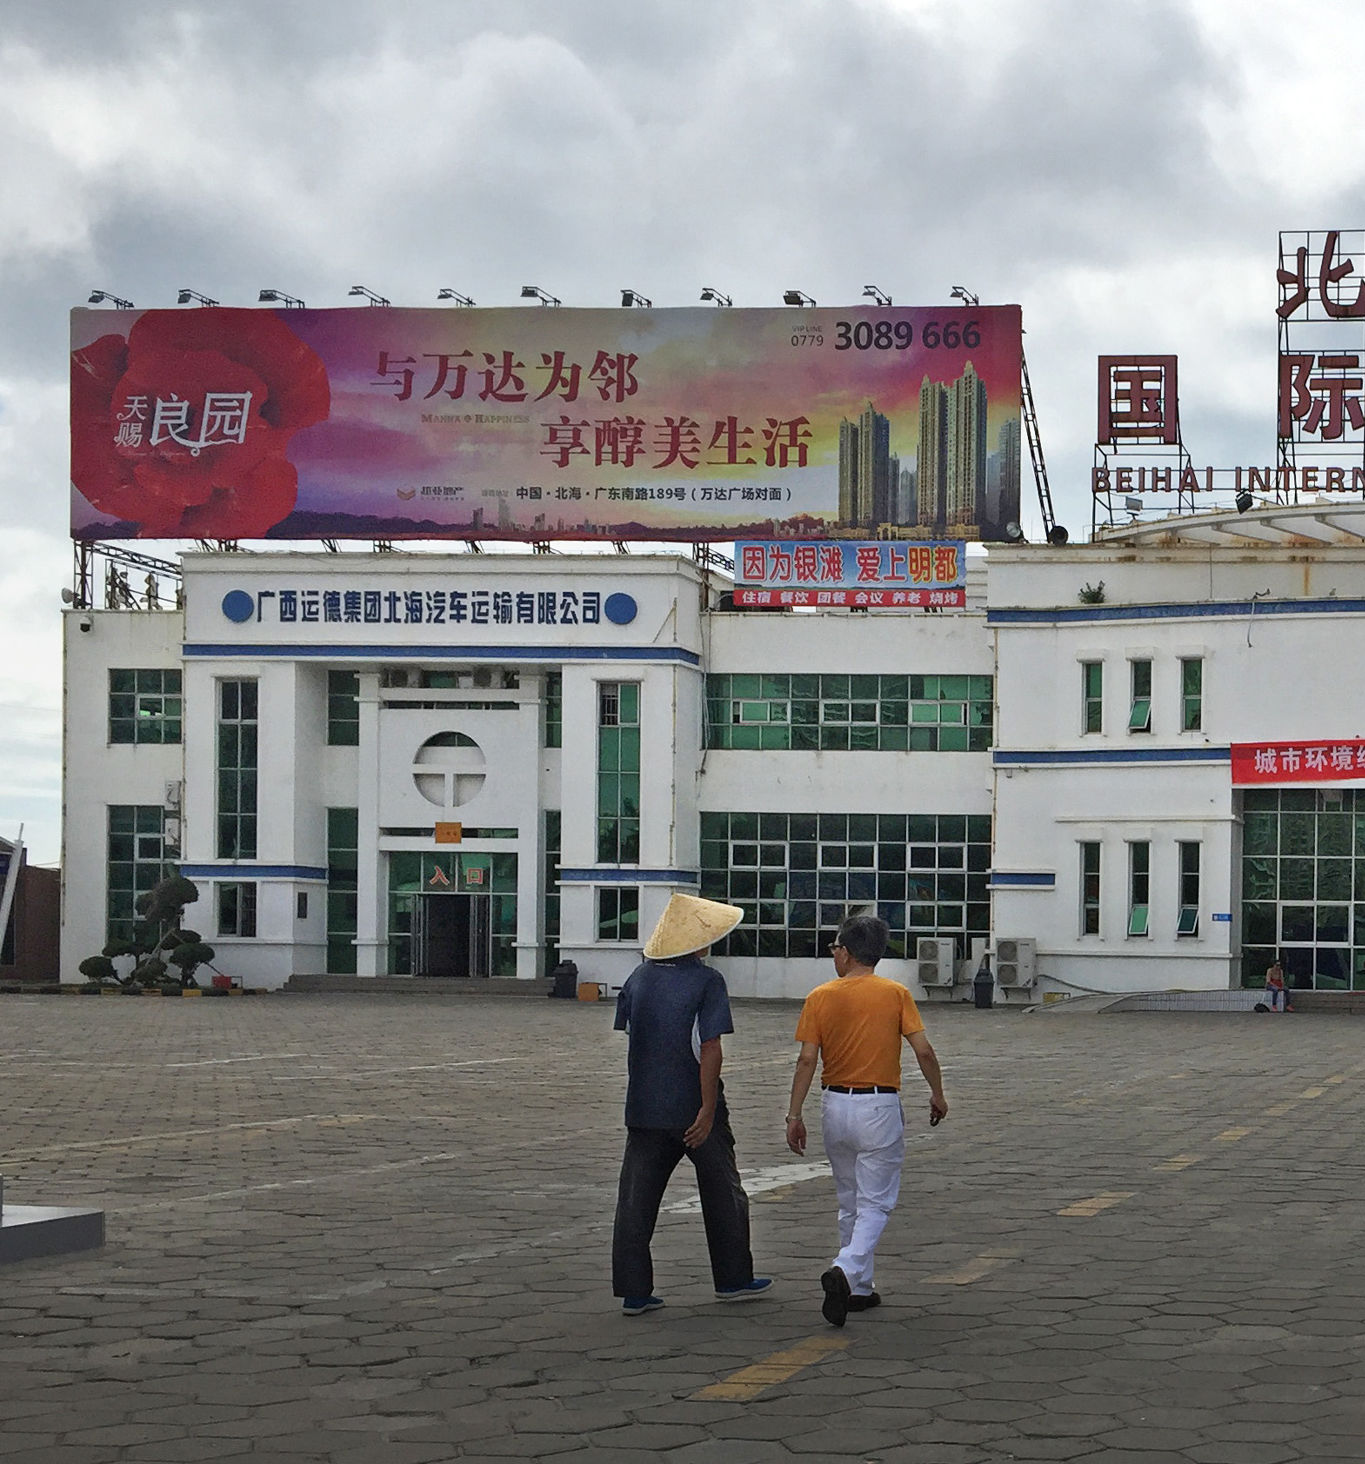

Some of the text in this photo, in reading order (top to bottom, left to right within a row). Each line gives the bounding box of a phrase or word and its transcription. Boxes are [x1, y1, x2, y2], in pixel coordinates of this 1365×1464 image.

[791, 321, 981, 350] 0779 3089 666
[369, 350, 639, 402] 与万达为邻
[113, 390, 253, 457] 天赐 良园
[539, 415, 813, 469] 享醇美生活
[1091, 466, 1214, 493] BEIHAI
[742, 545, 959, 583] 因为银滩 爱上明都
[256, 590, 602, 625] 广西运德集团北海汽车运输有限公司
[742, 591, 771, 604] 住宿
[780, 591, 809, 604] 餐饮
[854, 591, 884, 604] 会议
[892, 591, 922, 604] 养老
[929, 591, 958, 604] 烧烤
[429, 865, 483, 885] 入口
